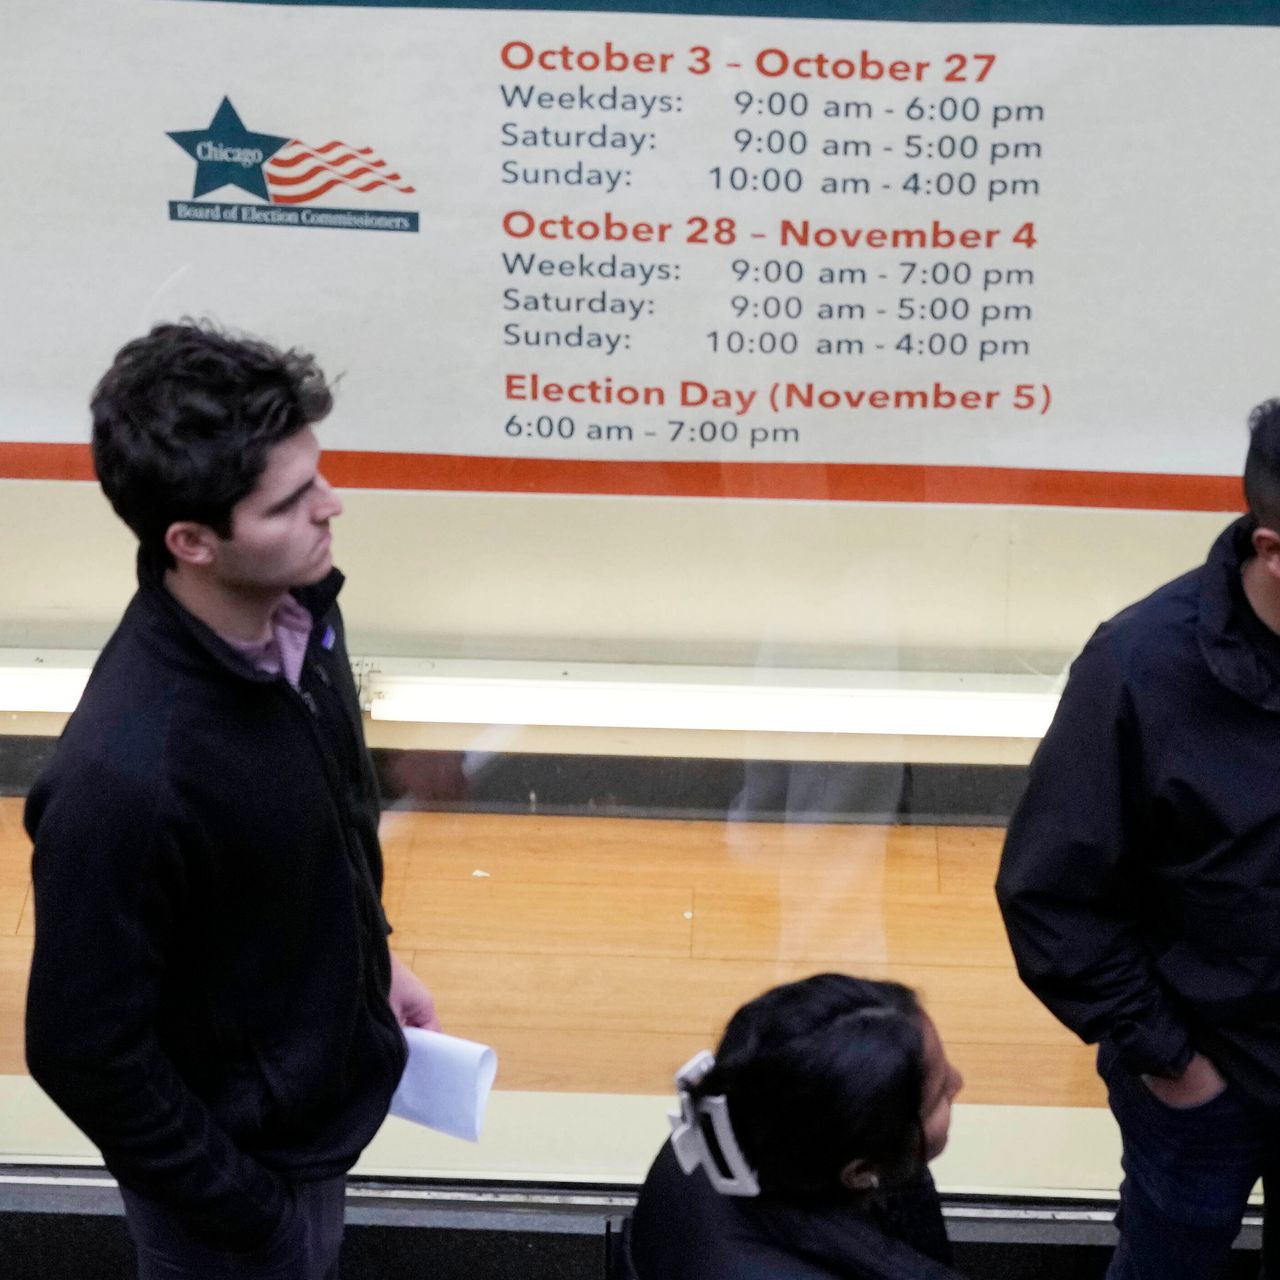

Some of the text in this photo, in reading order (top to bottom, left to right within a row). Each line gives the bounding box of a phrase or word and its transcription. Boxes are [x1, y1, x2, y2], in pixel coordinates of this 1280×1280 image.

[501, 41, 674, 73] October
[688, 46, 710, 75] 3
[756, 48, 930, 81] October
[944, 54, 996, 82] 27
[500, 85, 682, 118] Weekdays:
[735, 91, 808, 116] 9:00
[824, 101, 872, 118] am
[906, 97, 980, 121] 6:00
[993, 105, 1044, 128] pm
[196, 141, 263, 168] Chicago
[502, 123, 655, 156] Saturday:
[734, 129, 807, 155] 9:00
[823, 140, 871, 157] am
[905, 135, 978, 159] 5:00
[990, 142, 1041, 165] pm
[502, 161, 630, 193] Sunday:
[710, 167, 802, 192] 10:00
[821, 178, 870, 194] am
[902, 172, 976, 195] 4:00
[988, 179, 1039, 202] pm
[177, 204, 410, 228] Board of Election Commissioners
[503, 211, 672, 242] October
[687, 216, 736, 245] 28
[781, 220, 1000, 248] November
[1012, 222, 1037, 248] 4
[502, 252, 679, 286] Weekdays:
[732, 259, 803, 283] 9:00
[819, 268, 866, 284] am
[900, 262, 971, 285] 7:00
[984, 269, 1034, 291] pm
[503, 288, 653, 321] Saturday:
[731, 296, 802, 319] 9:00
[818, 304, 865, 319] am
[898, 298, 969, 320] 5:00
[982, 305, 1031, 327] pm
[504, 323, 630, 355] Sunday:
[707, 331, 798, 354] 10:00
[817, 339, 863, 354] am
[895, 333, 967, 355] 4:00
[979, 340, 1029, 362] pm
[506, 373, 1051, 415] Election Day (November 5)
[505, 415, 575, 439] 6:00
[587, 425, 633, 440] am
[668, 421, 738, 442] 7:00
[750, 428, 799, 449] pm
